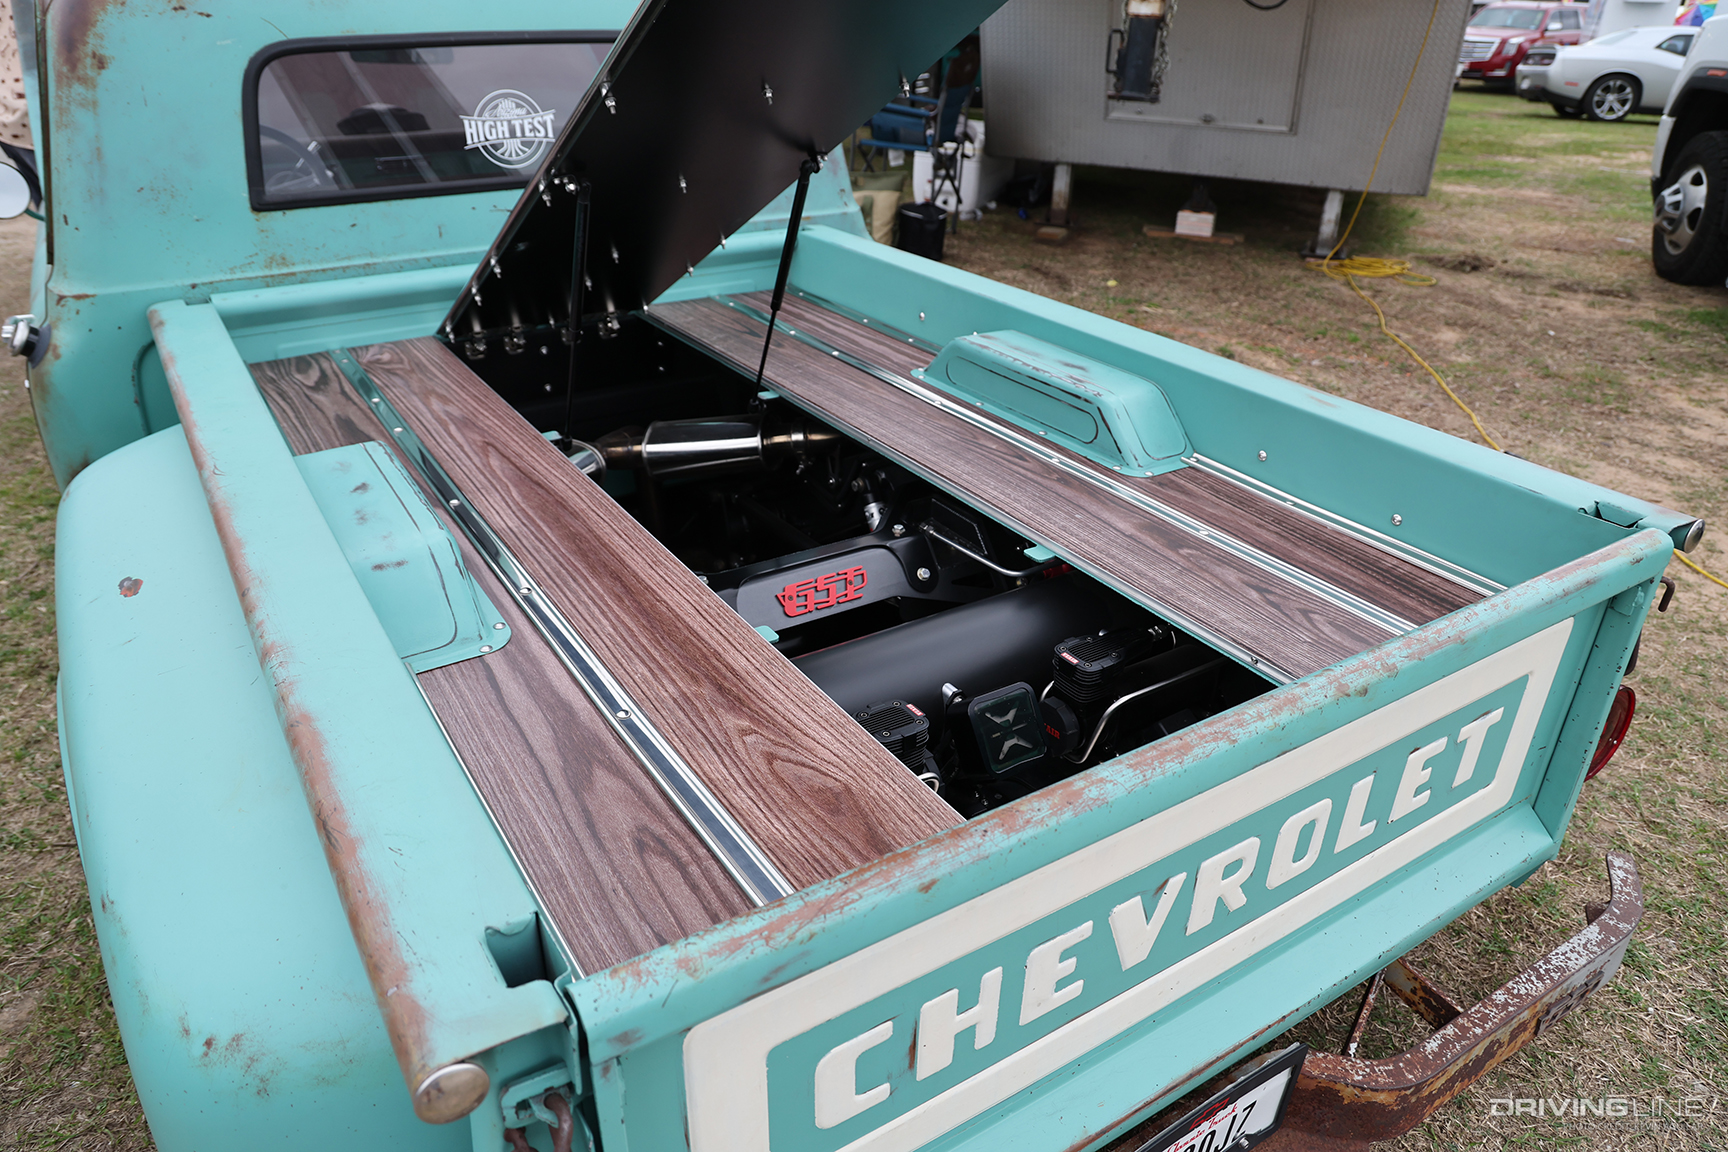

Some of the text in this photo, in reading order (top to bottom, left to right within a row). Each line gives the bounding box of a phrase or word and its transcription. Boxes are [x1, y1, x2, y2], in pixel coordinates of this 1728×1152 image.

[463, 113, 555, 144] HIGH TEST
[814, 706, 1504, 1129] CHEVROLET
[1208, 1102, 1238, 1129] Truck
